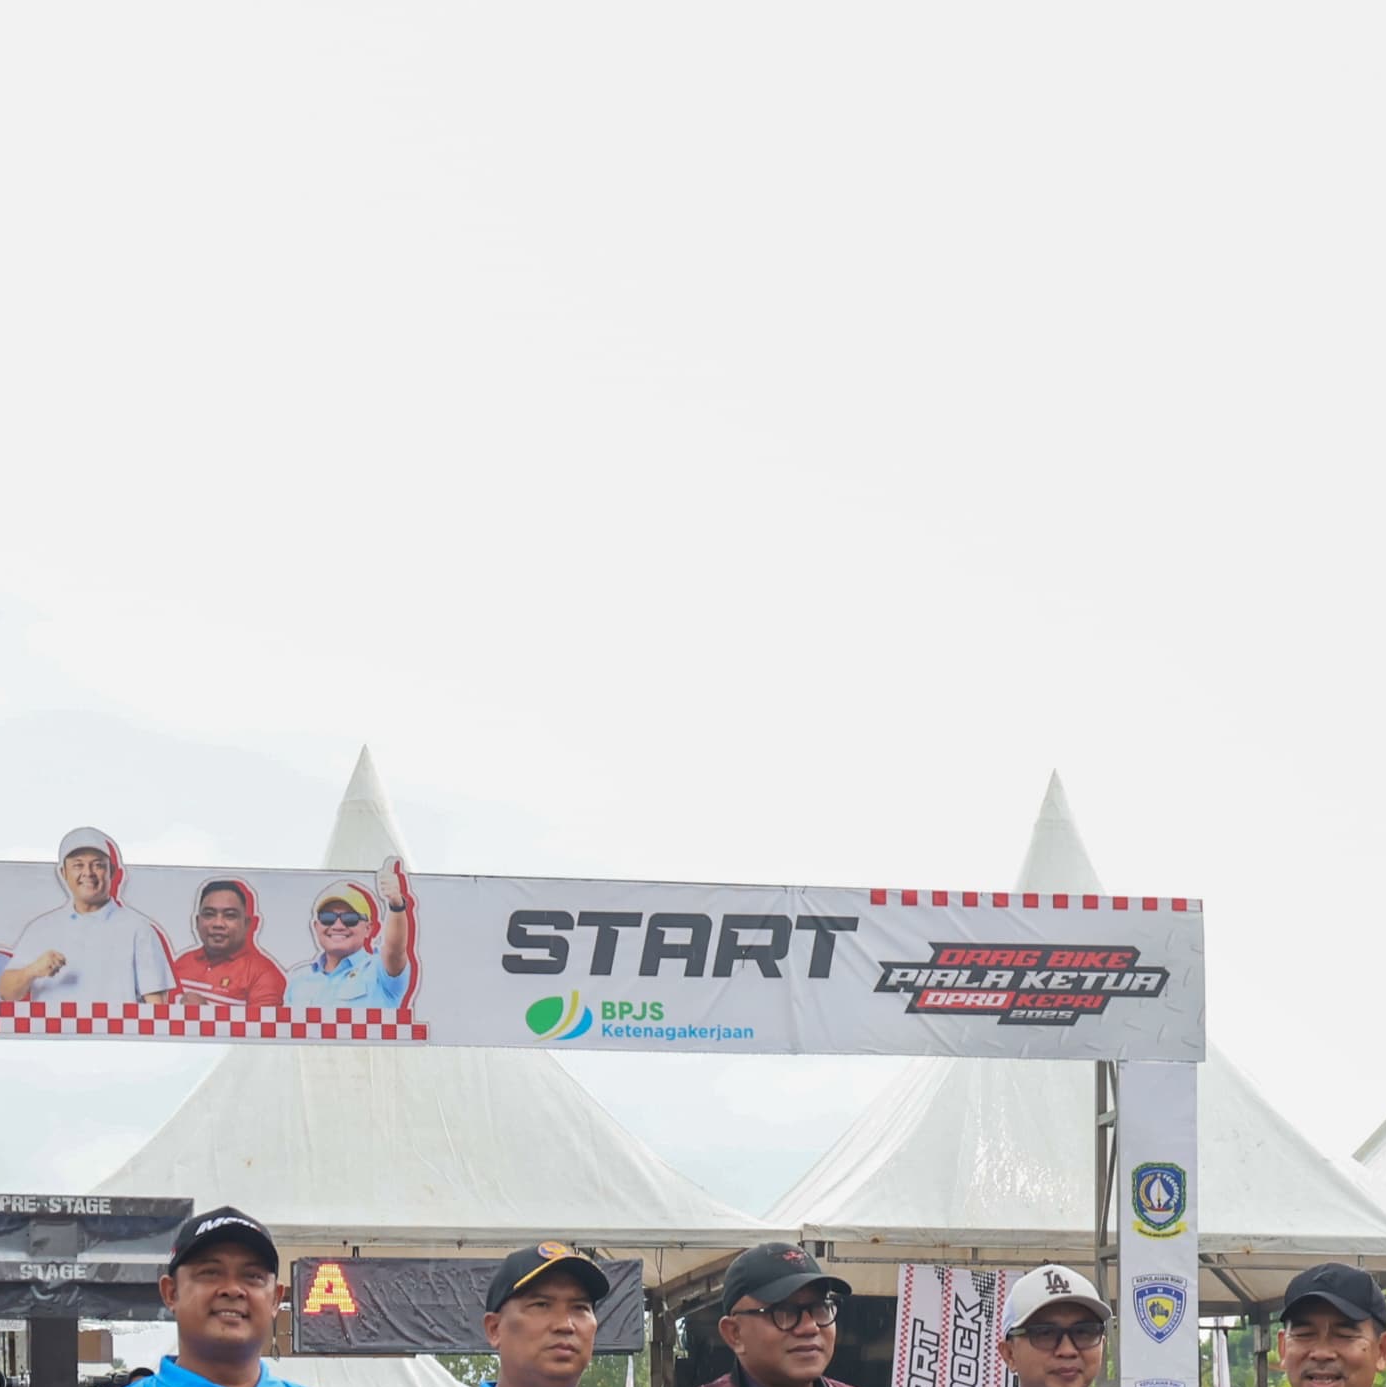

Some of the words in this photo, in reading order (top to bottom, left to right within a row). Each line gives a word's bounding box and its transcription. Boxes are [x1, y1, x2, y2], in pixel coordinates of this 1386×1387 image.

[502, 910, 859, 979] START
[936, 949, 1042, 967] DRAG
[1046, 951, 1137, 969] BIKE
[885, 968, 1015, 989] PIALA
[1019, 971, 1163, 991] KETUA
[924, 992, 1008, 1007] DPRD
[1015, 994, 1104, 1009] KEPRI
[601, 1001, 665, 1021] BPJS
[1009, 1010, 1073, 1020] 2025
[601, 1024, 754, 1041] Ketenagakerjaan
[20, 1264, 88, 1280] STAGE
[303, 1263, 356, 1313] A
